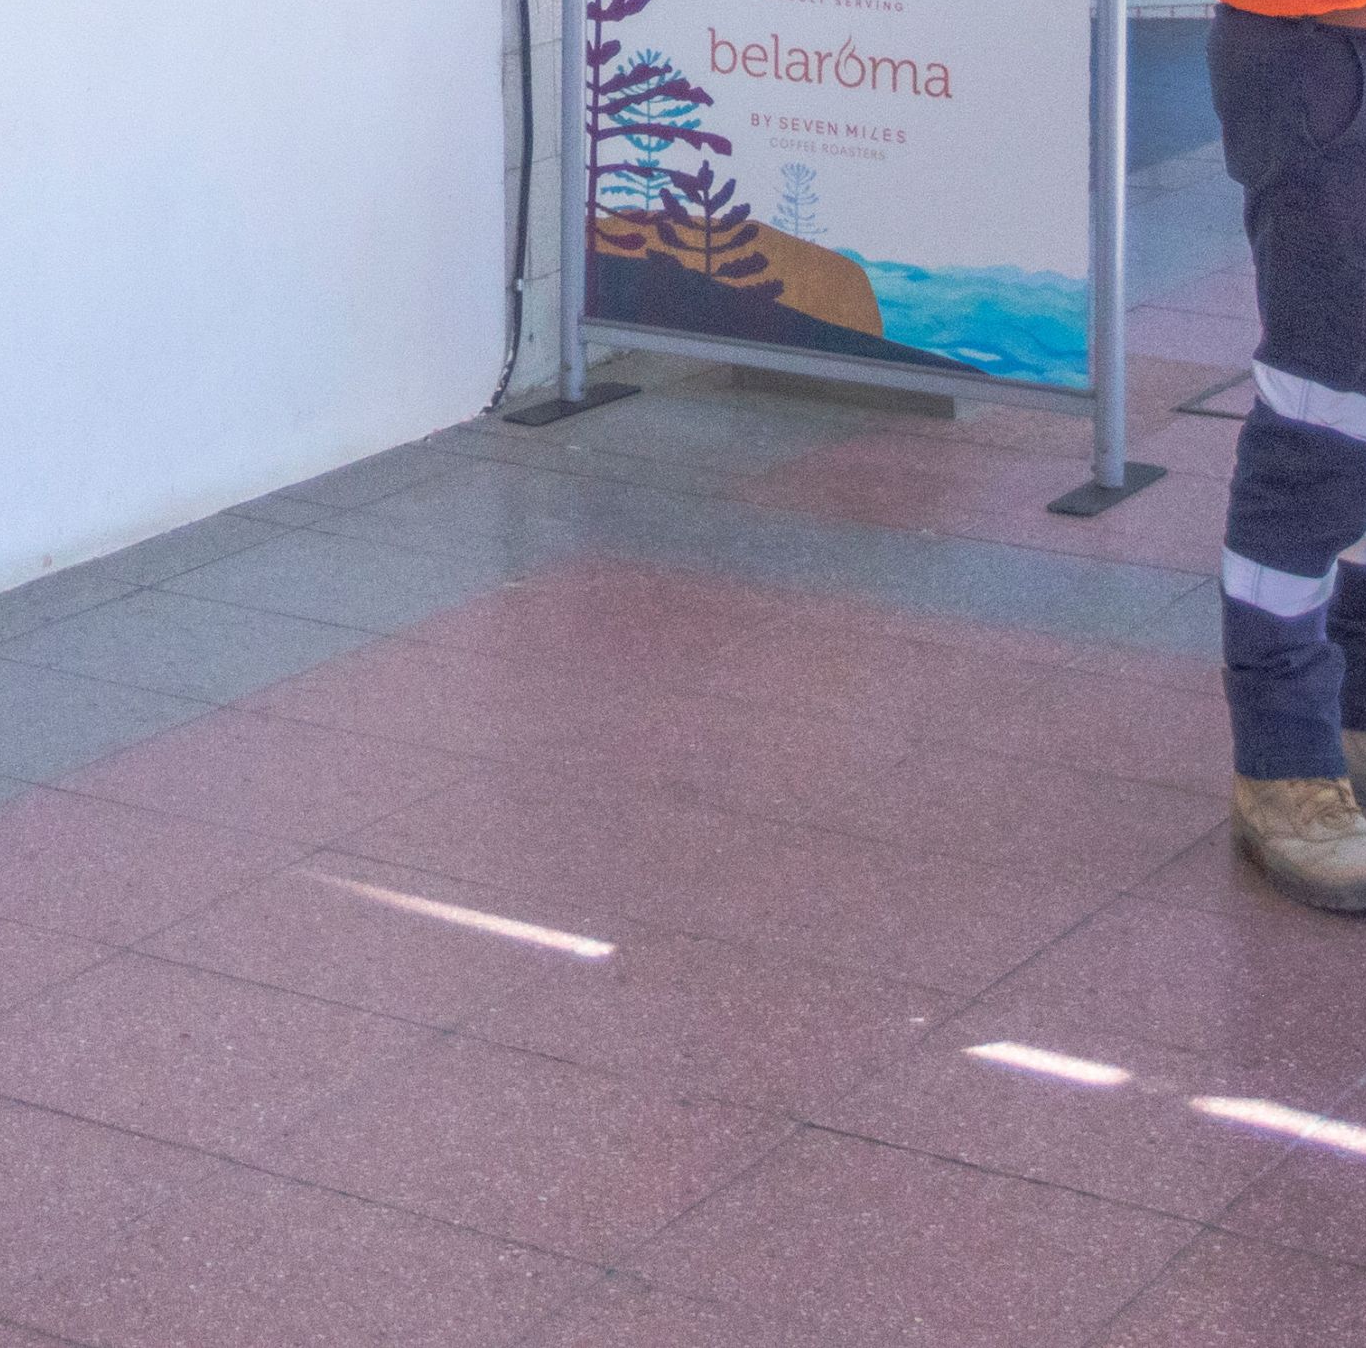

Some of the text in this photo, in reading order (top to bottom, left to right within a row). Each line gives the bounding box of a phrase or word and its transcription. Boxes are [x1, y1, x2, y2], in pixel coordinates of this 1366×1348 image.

[750, 113, 908, 145] BY SEVEN MILES
[769, 136, 887, 162] COFFEE ROASTERS
